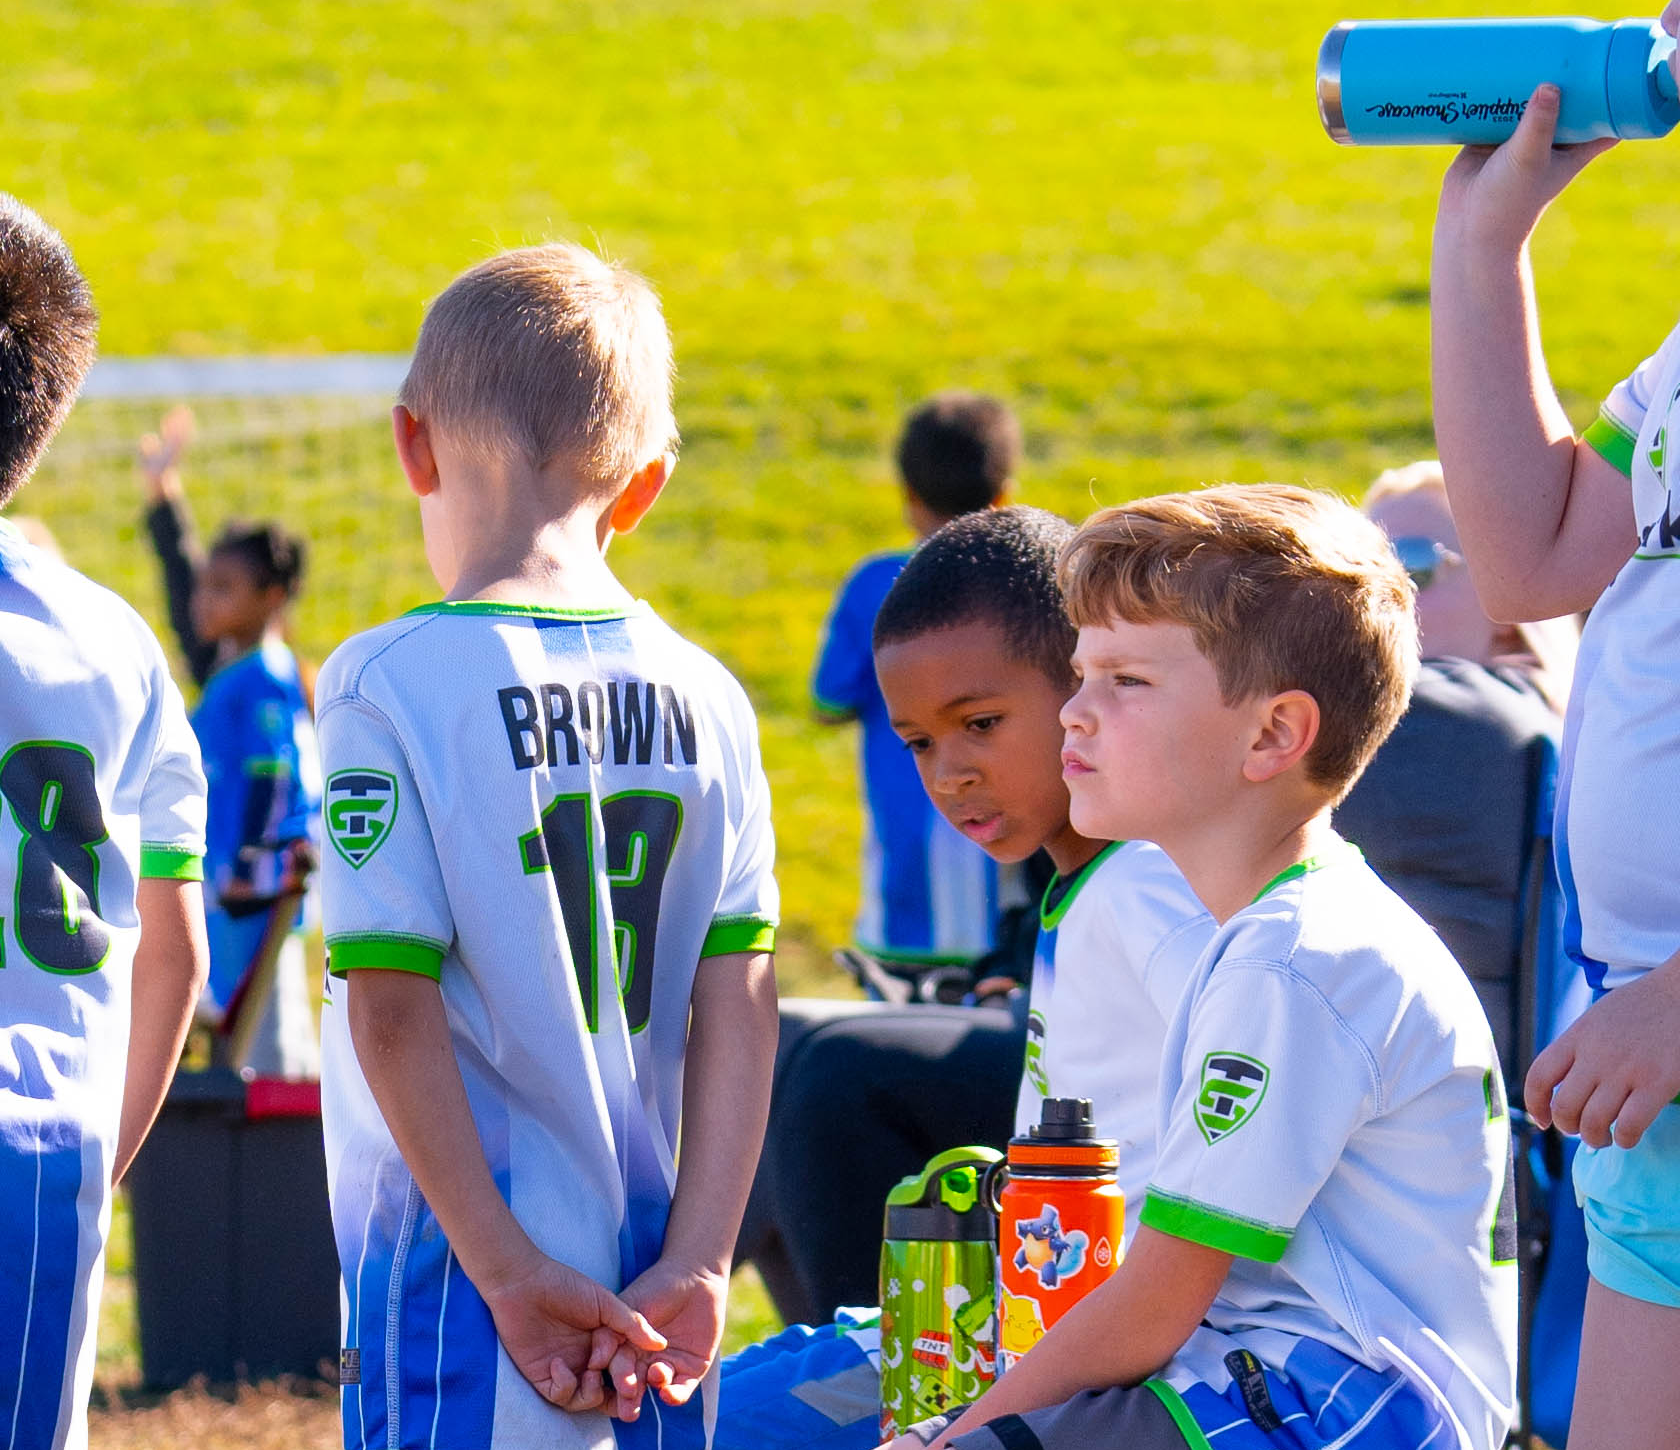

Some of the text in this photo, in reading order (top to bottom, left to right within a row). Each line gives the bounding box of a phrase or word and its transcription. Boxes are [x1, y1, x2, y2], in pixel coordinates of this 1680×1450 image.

[1365, 101, 1460, 125] Showcase
[498, 681, 698, 771] BROWN
[517, 788, 685, 1036] 13
[920, 1340, 946, 1352] TNT
